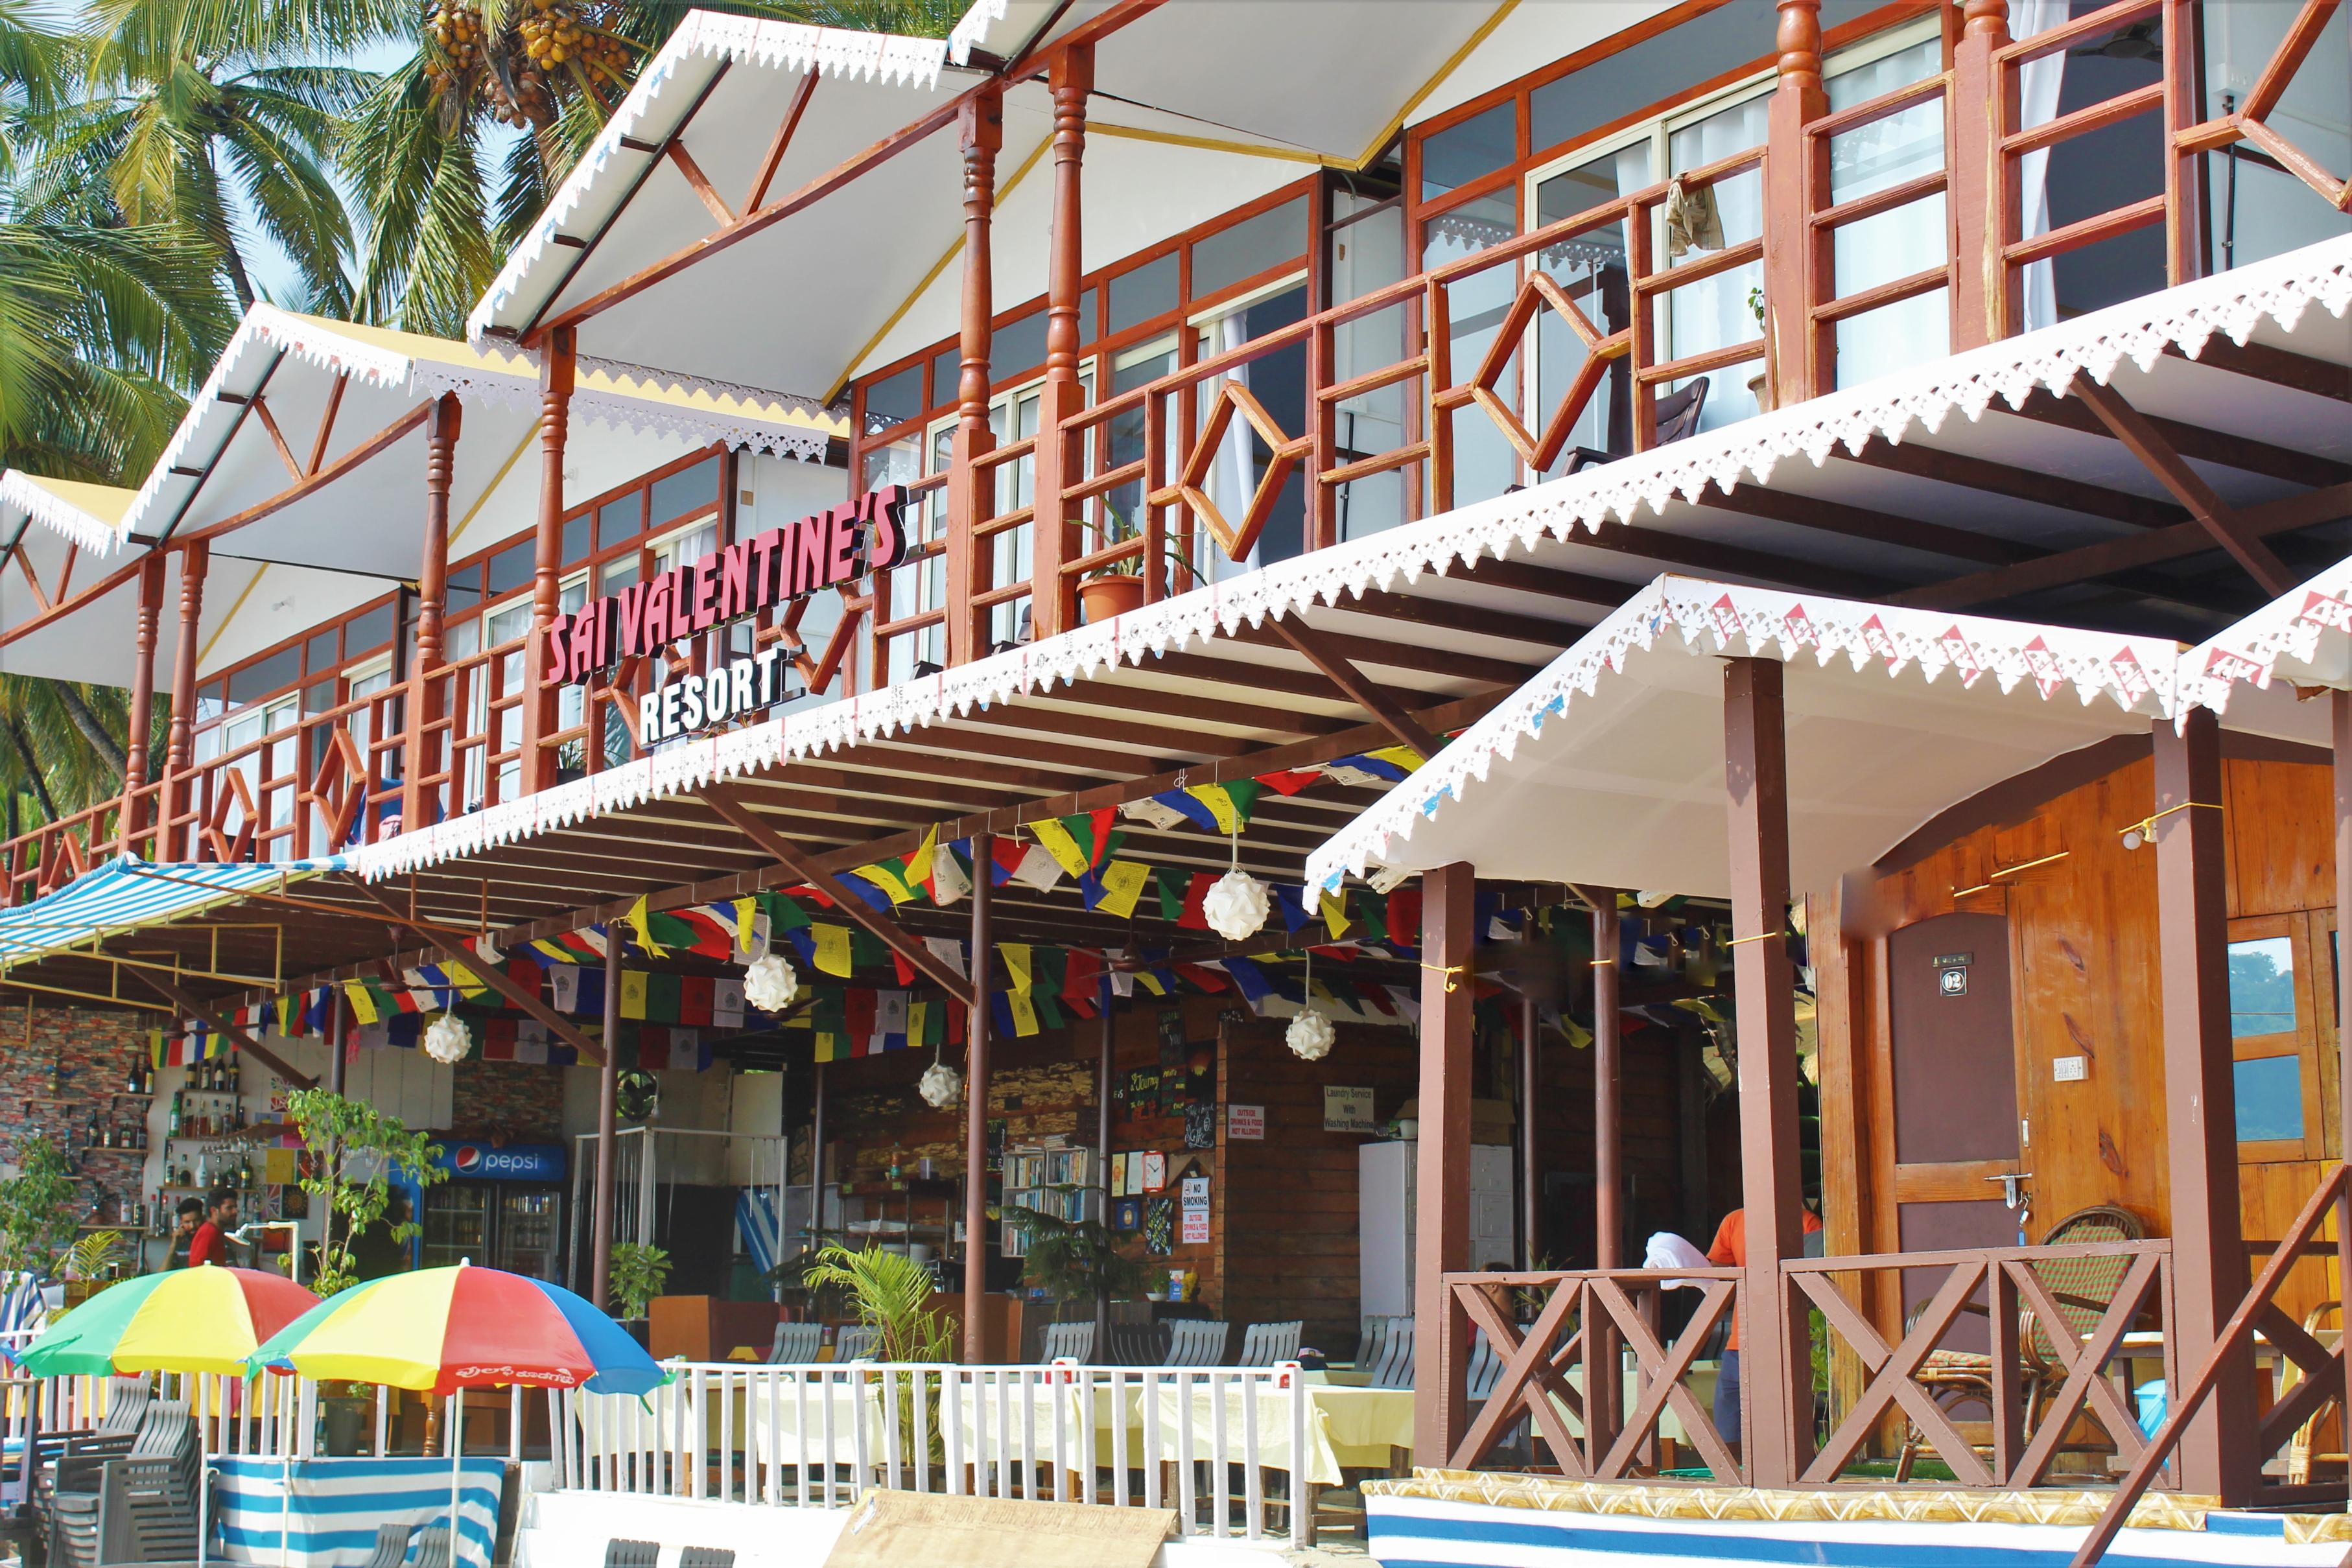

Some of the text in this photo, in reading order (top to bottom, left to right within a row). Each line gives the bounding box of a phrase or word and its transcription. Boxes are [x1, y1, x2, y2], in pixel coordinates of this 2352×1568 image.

[548, 484, 909, 685] SAI VALENTINE'S
[640, 648, 787, 747] RESORT
[1944, 974, 1961, 989] 02
[1136, 1075, 1159, 1092] Journey
[1326, 1087, 1371, 1099] Laundry Service
[1343, 1104, 1356, 1114] With
[1324, 1117, 1374, 1130] Washing Machine
[486, 1153, 539, 1172] pepsi
[1194, 1184, 1201, 1193] NO
[1183, 1197, 1207, 1206] SMOKING
